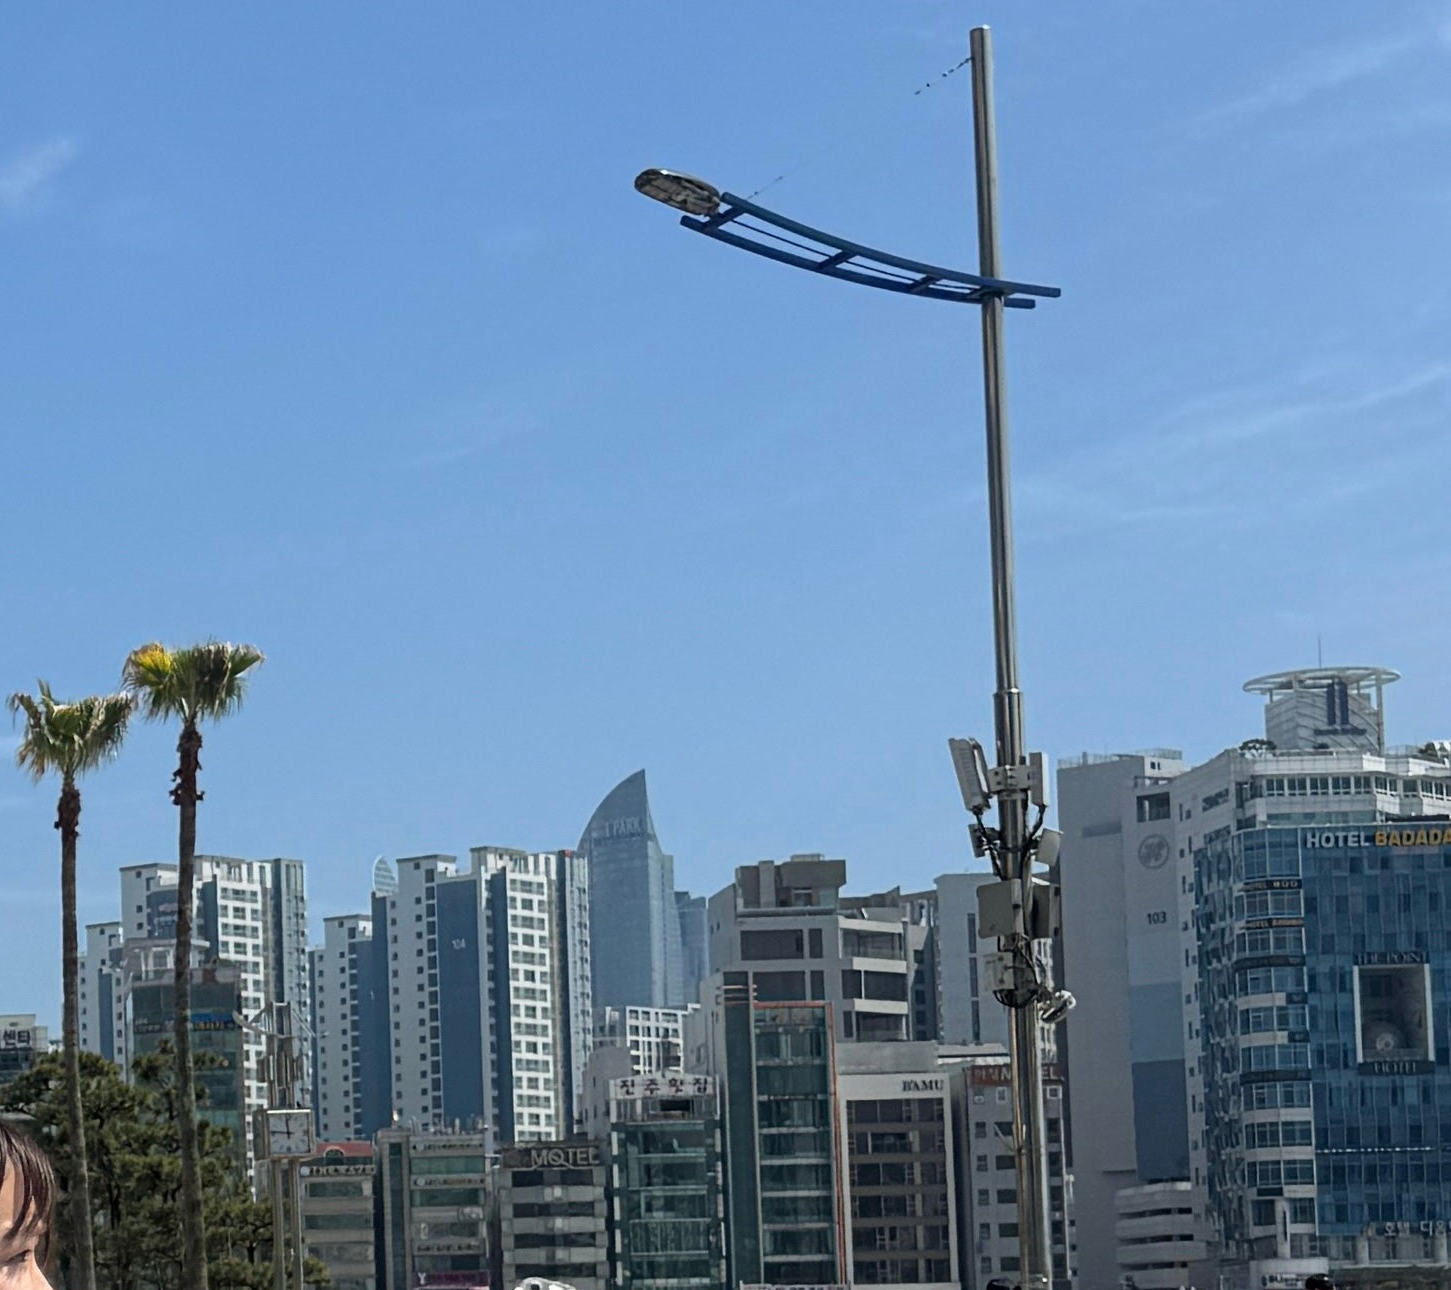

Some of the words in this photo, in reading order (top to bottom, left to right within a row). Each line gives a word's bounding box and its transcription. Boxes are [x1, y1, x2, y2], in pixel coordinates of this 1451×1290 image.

[1306, 831, 1370, 848] HOTEL
[1147, 911, 1167, 925] 103
[620, 1077, 708, 1096] 진주횟집
[530, 1147, 600, 1168] MOTEL
